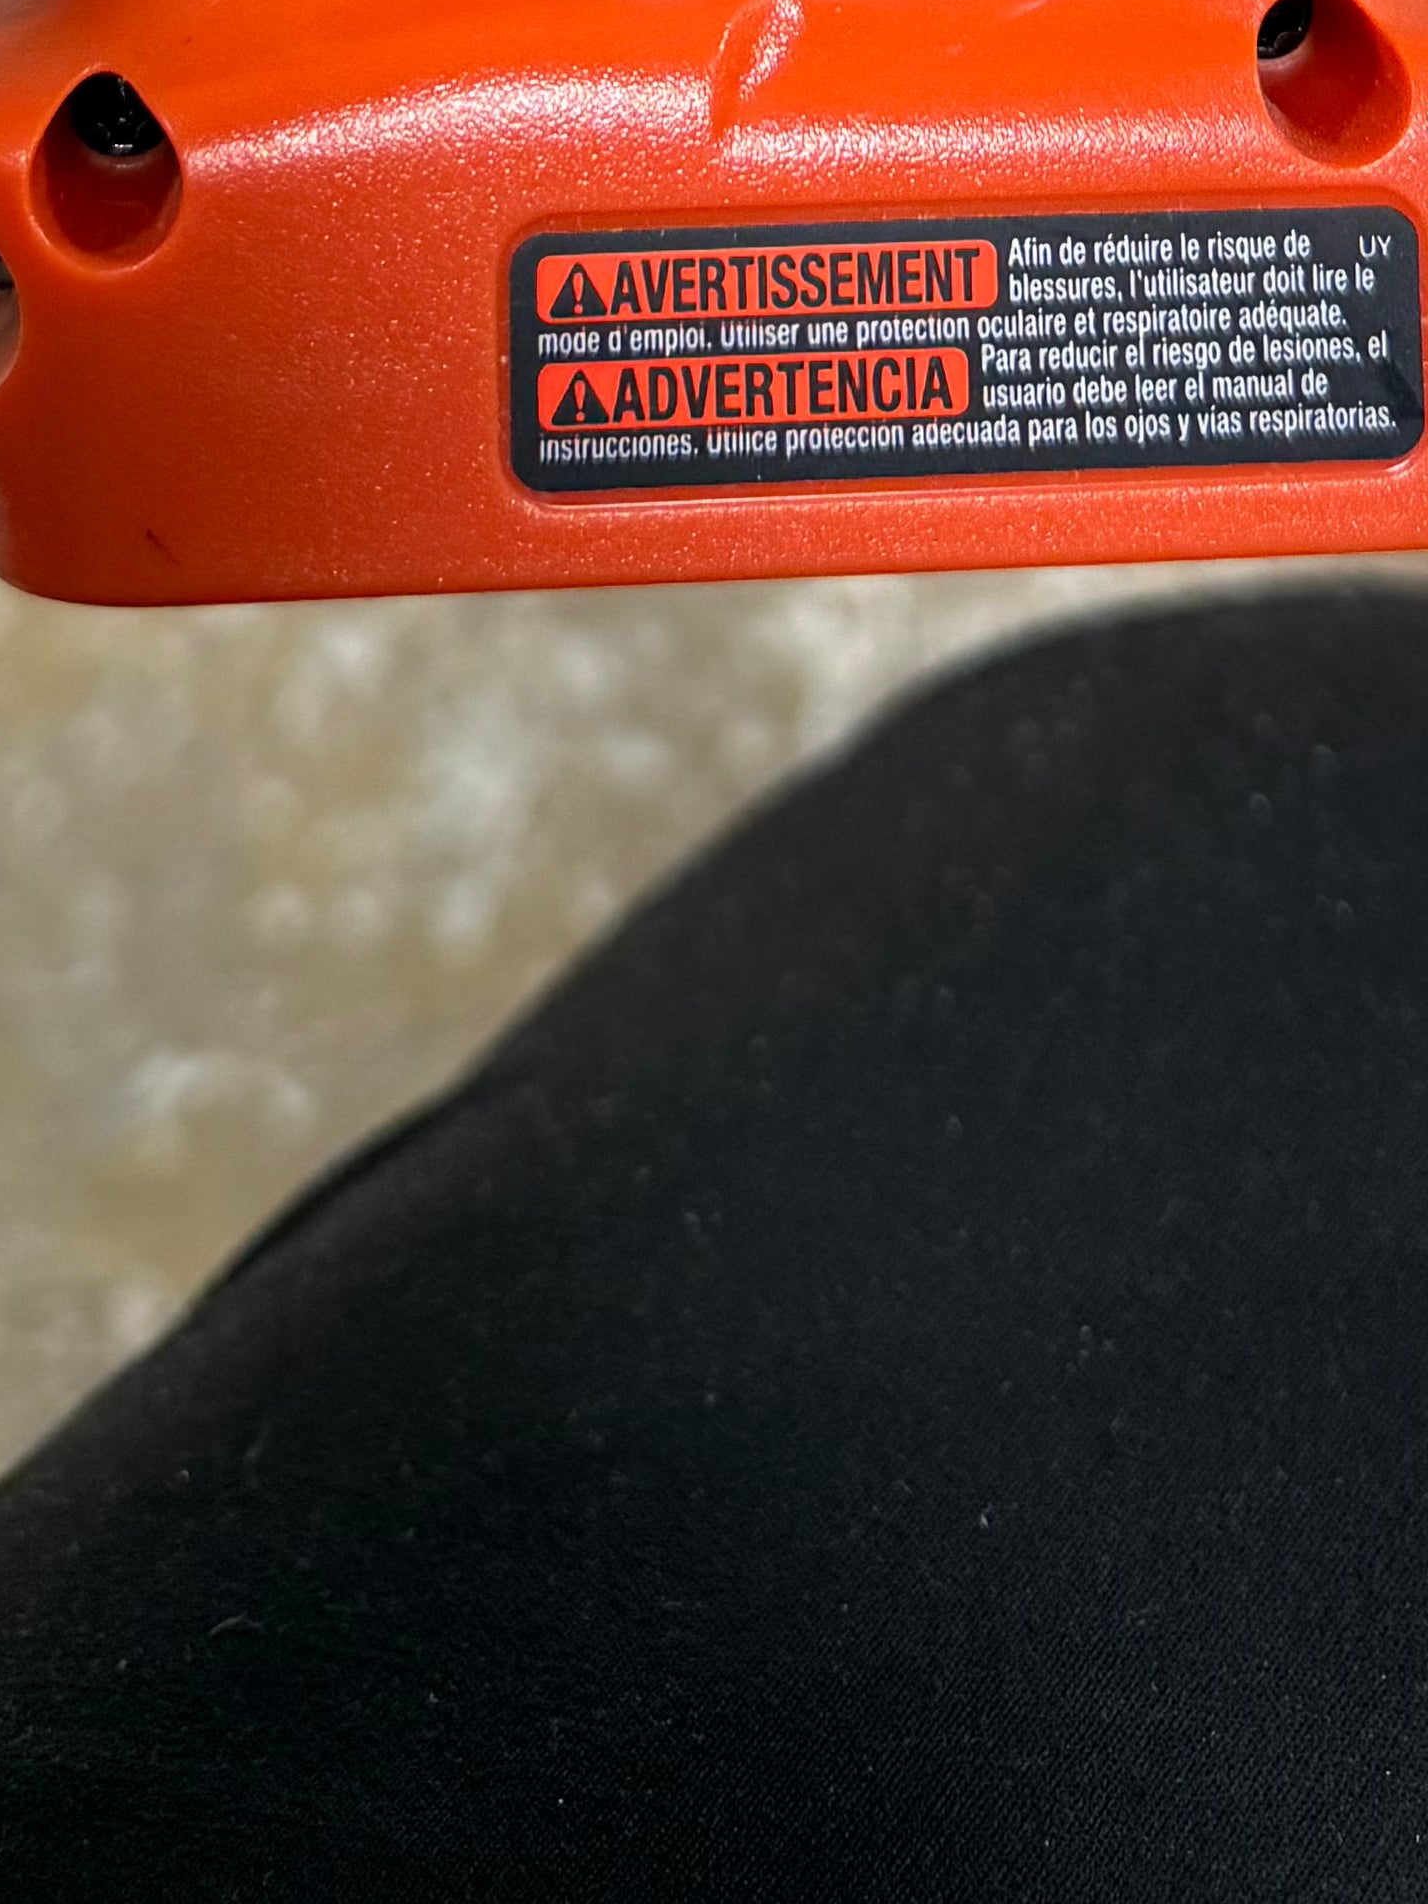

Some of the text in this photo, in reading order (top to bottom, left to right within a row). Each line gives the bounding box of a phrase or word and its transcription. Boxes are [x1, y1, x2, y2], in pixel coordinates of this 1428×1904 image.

[1008, 229, 1392, 267] Afin de réduire le risque de UY
[610, 248, 980, 315] AVERTISSEMENT
[1009, 262, 1375, 303] blessures, l'utilisateur doit lire le
[538, 299, 1347, 356] mode d'emploi. Utiliser une protection oculaire et respiratoire adéquate.
[981, 330, 1388, 373] Para reducir el riesgo de lesiones, el
[613, 356, 953, 422] ADVERTENCIA
[982, 367, 1329, 409] usuario debe leer el manual de
[912, 414, 1021, 444] adecuada
[1028, 414, 1078, 450] para
[1085, 411, 1117, 440] los
[1125, 409, 1171, 444] ojos
[1178, 412, 1191, 443] y
[1197, 404, 1242, 435] vías
[1250, 401, 1397, 437] respiratorias.
